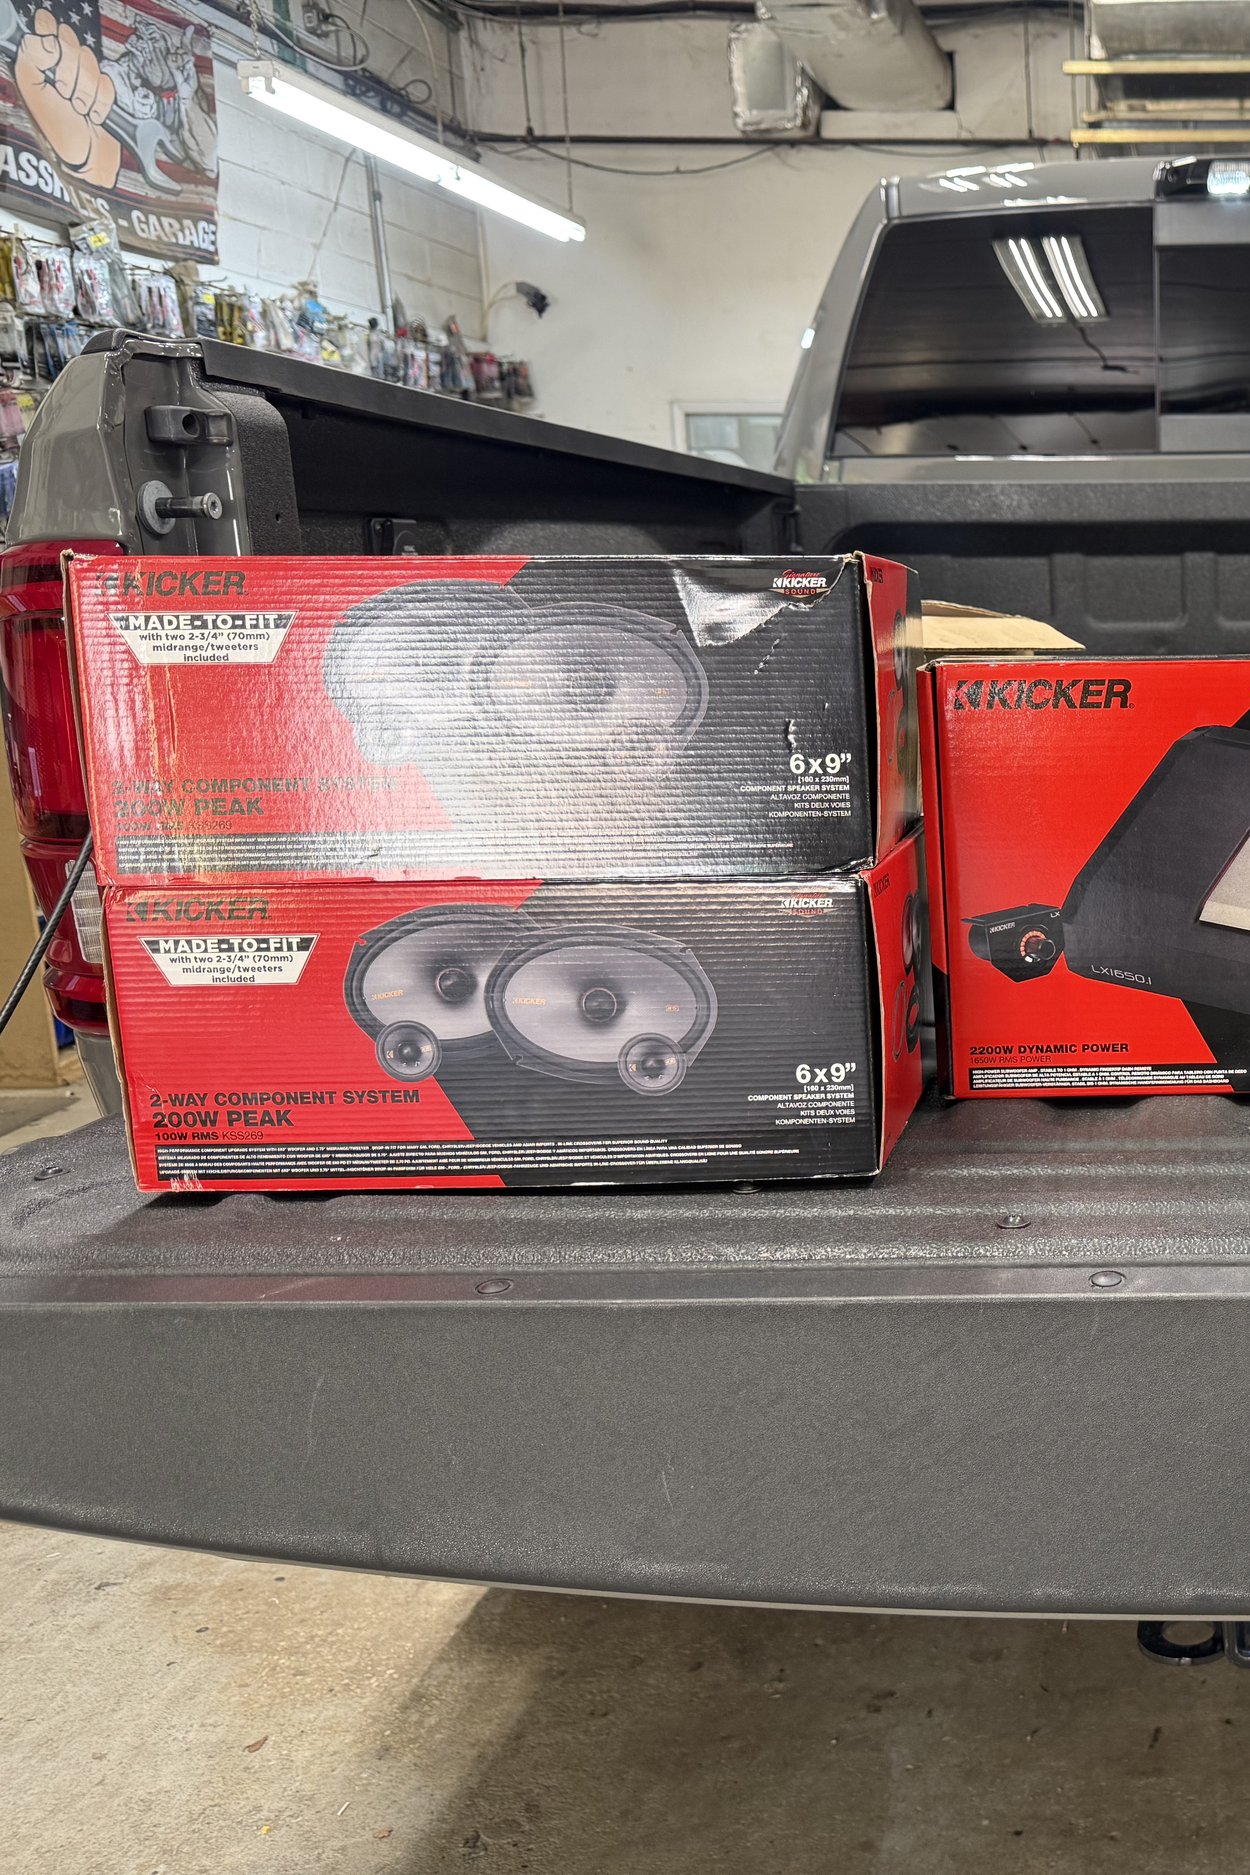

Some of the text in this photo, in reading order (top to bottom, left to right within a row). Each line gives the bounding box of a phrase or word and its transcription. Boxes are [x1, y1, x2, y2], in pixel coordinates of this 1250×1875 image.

[131, 209, 216, 251] GARAGE
[122, 571, 246, 597] KICKER
[782, 577, 827, 588] KICKER
[129, 614, 278, 630] MADE-TO-FIT
[139, 632, 162, 641] with
[165, 632, 185, 641] two
[227, 631, 271, 641] (70mm)
[152, 642, 259, 652] midrange/tweeters
[183, 653, 229, 662] included
[986, 679, 1132, 710] KICKER
[111, 776, 398, 795] 2-WAY COMPONENT SYSTEM
[114, 797, 264, 817] 200W PEAK
[768, 810, 851, 818] KOMPONENTEN-SYSTEM
[790, 898, 833, 908] KICKER
[152, 897, 268, 921] KICKER
[159, 937, 301, 953] MADE-TO-FIT
[169, 955, 191, 964] with
[194, 955, 213, 963] two
[252, 954, 293, 964] (70mm)
[182, 965, 283, 975] midrange/tweeters
[212, 975, 255, 983] included
[970, 1043, 1129, 1055] 2200W DYNAMIC POWER
[970, 1055, 1051, 1064] 1650W RMS POWER
[150, 1089, 419, 1107] 2-WAY COMPONENT SYSTEM
[153, 1109, 294, 1128] 200W PEAK
[775, 1117, 855, 1125] KOMPONENTEN-SYSTEM
[155, 1131, 264, 1140] 100W RMS KSS269
